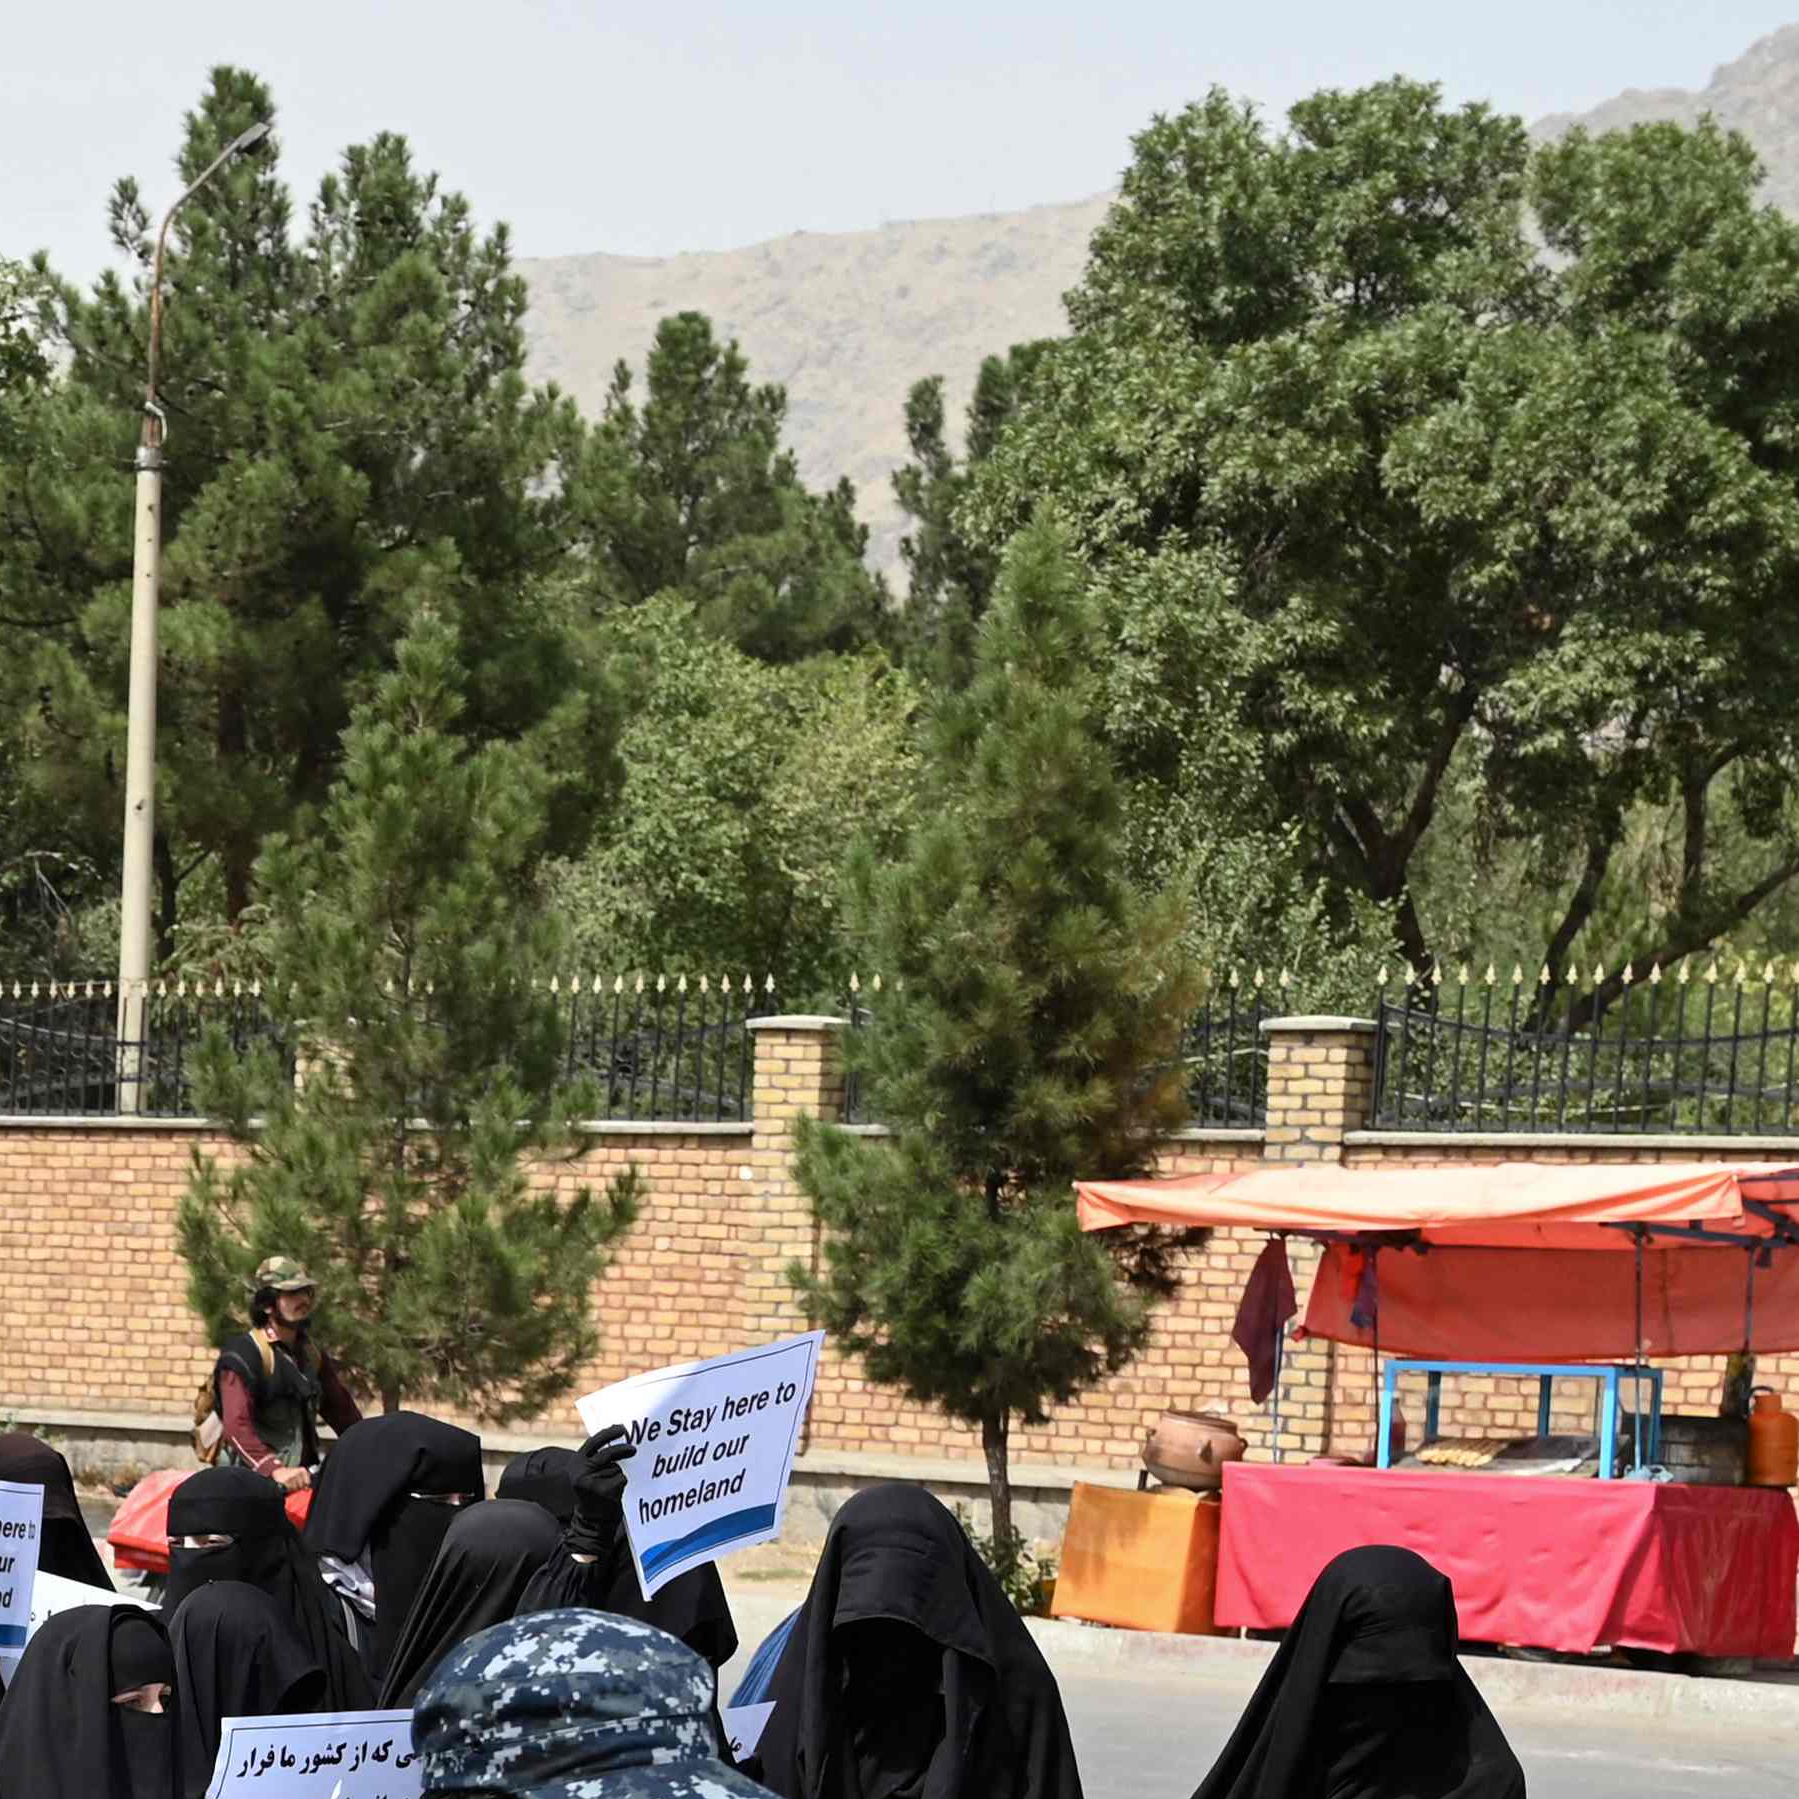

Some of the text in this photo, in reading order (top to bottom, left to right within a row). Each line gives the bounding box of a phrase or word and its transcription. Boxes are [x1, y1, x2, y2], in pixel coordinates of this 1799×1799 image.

[626, 1382, 797, 1446] We Stay here to
[651, 1434, 751, 1480] build our
[638, 1468, 747, 1526] homeland
[236, 1743, 276, 1778] فرار
[280, 1744, 297, 1769] ما
[298, 1741, 348, 1775] کشور
[348, 1740, 368, 1772] از
[371, 1739, 394, 1763] که
